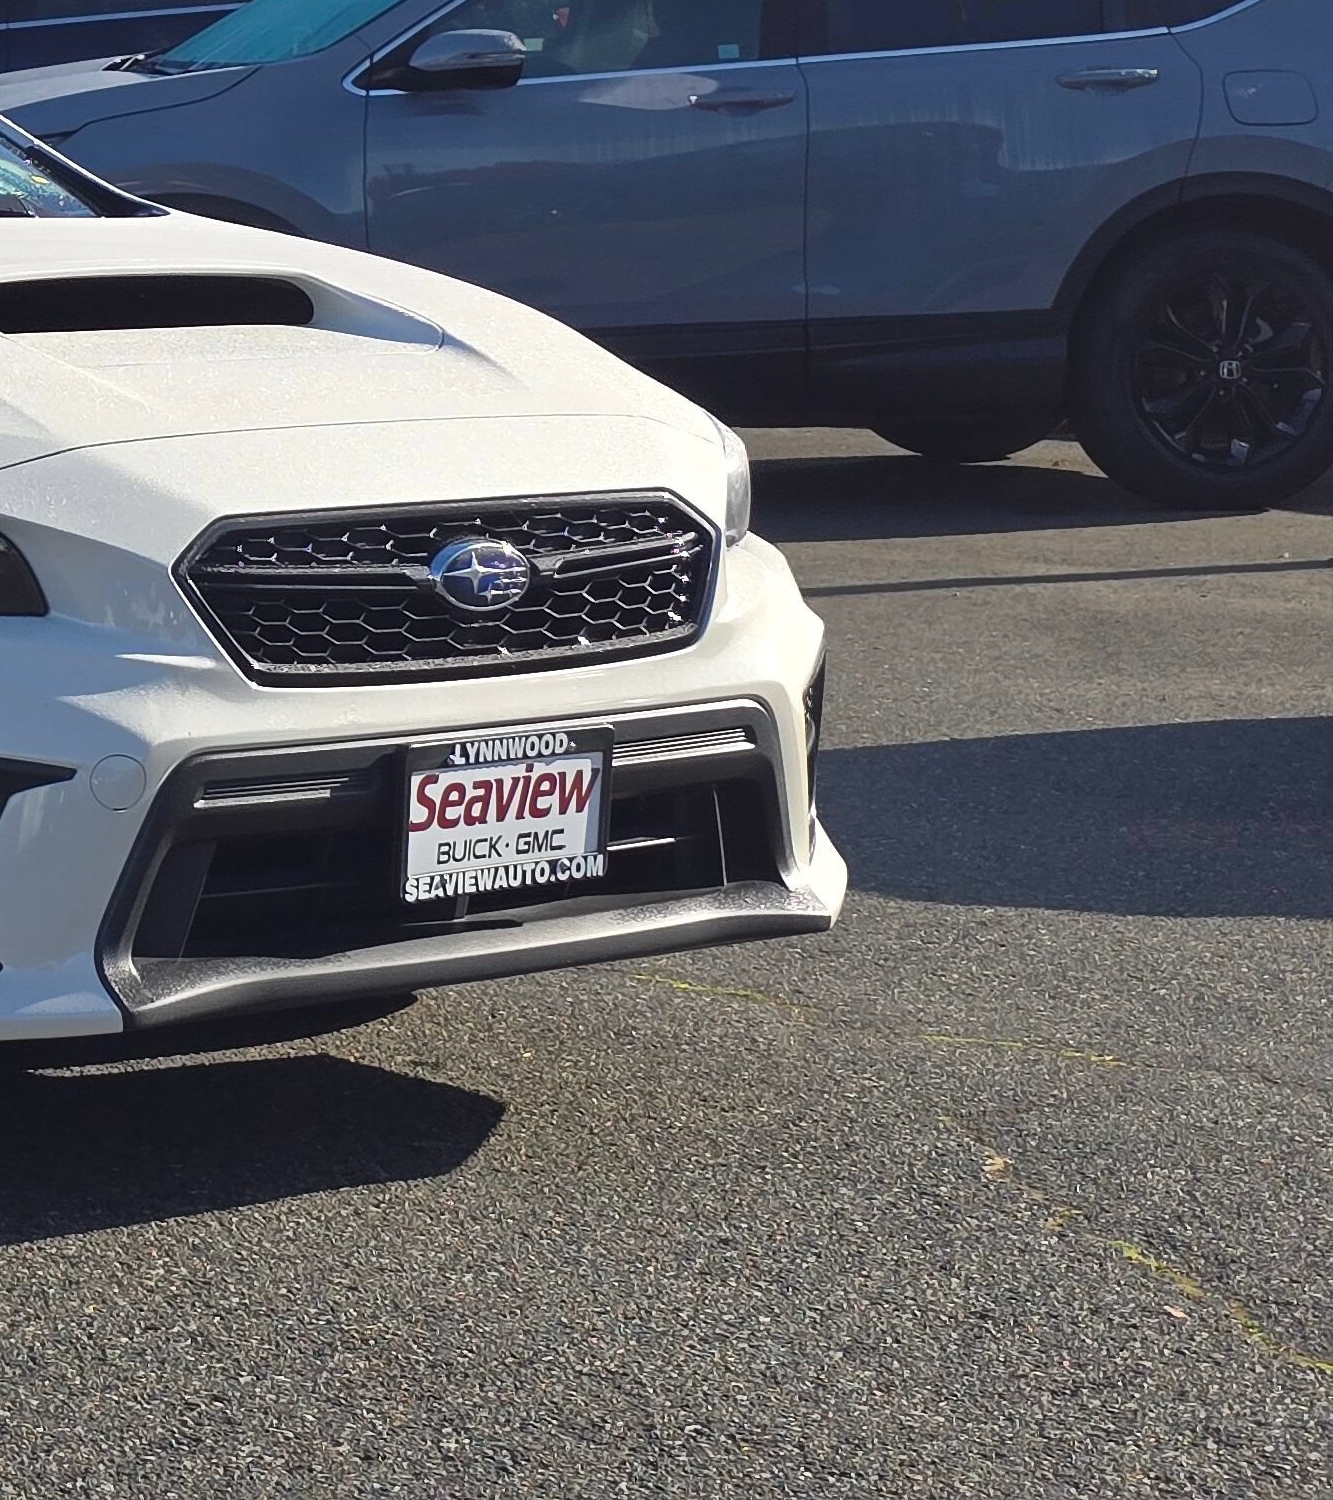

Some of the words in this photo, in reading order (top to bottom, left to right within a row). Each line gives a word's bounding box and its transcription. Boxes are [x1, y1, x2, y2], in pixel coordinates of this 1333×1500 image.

[454, 732, 569, 765] LYNNWOOD
[408, 763, 601, 833] Seaview
[436, 834, 503, 866] BUICK
[515, 828, 567, 856] GMC
[404, 853, 604, 904] SEAVIEWAUTO.COM
